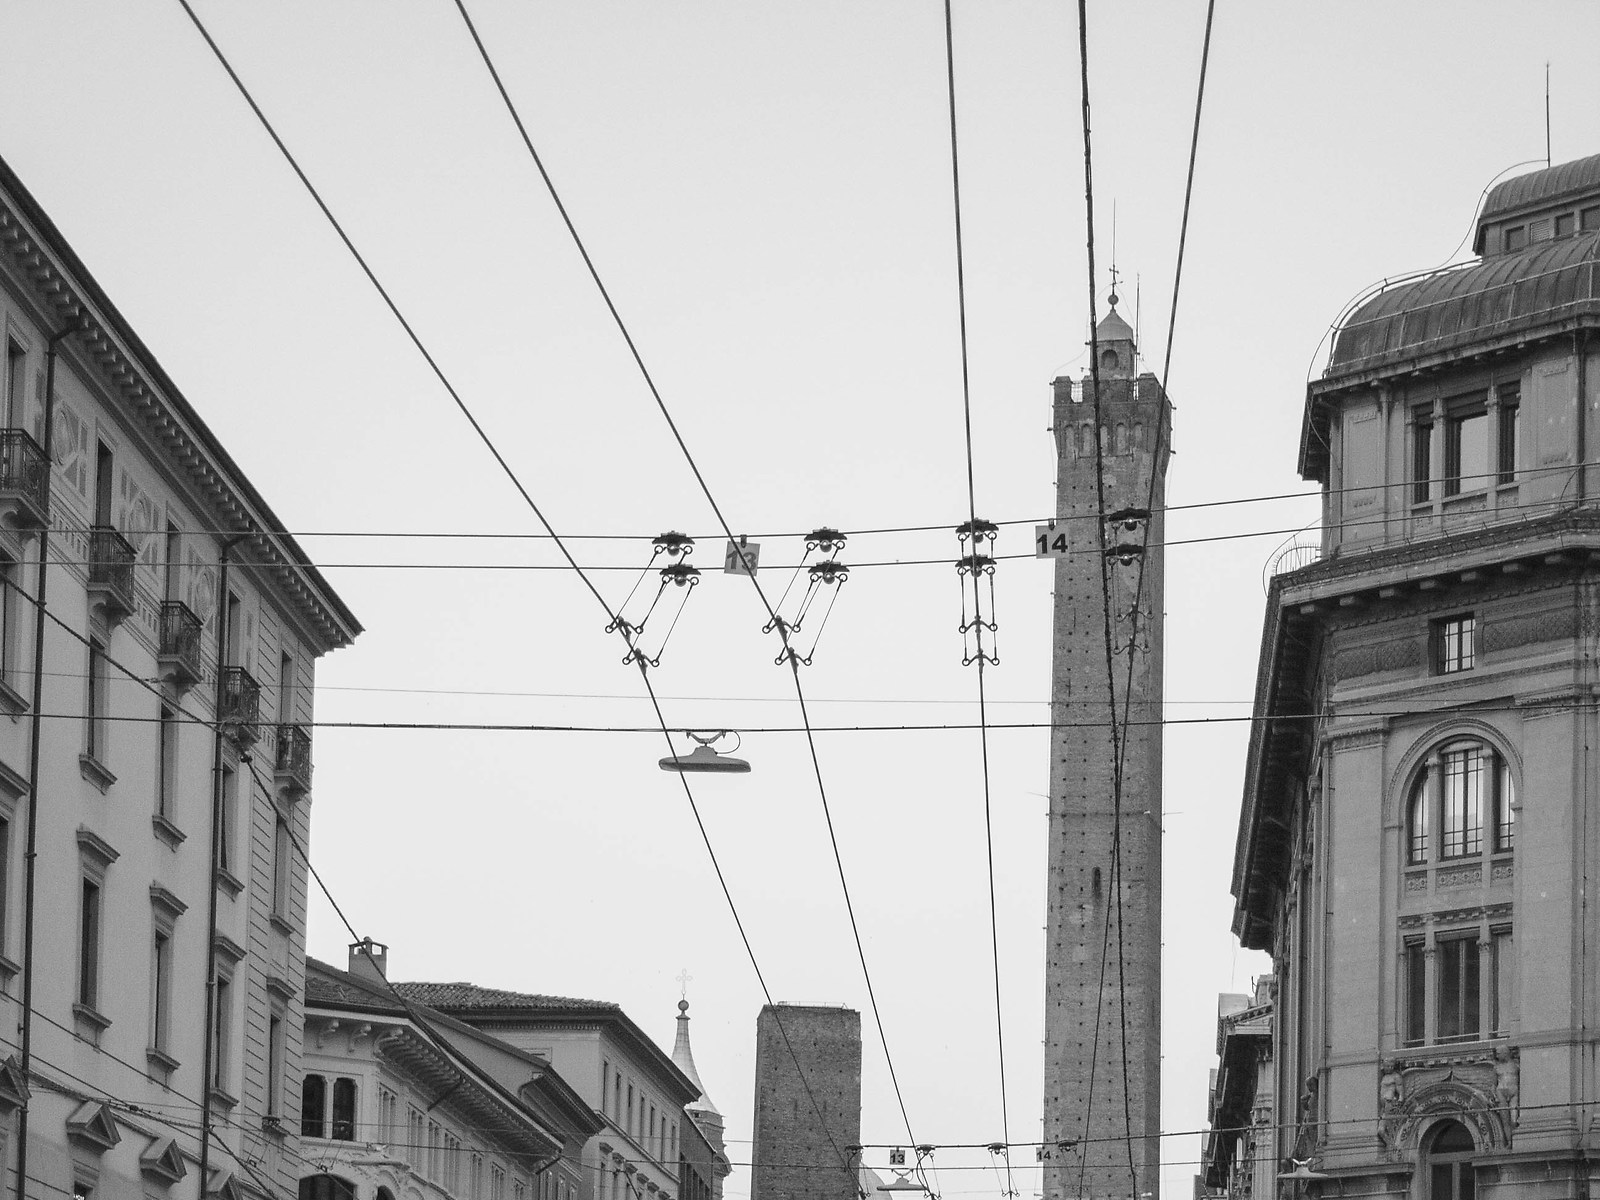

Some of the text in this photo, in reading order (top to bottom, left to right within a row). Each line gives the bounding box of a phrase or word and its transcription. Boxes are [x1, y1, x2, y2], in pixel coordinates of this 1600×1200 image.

[1036, 533, 1068, 554] 14
[727, 550, 757, 571] 13
[890, 1153, 905, 1163] 13
[1036, 1150, 1051, 1161] 14
